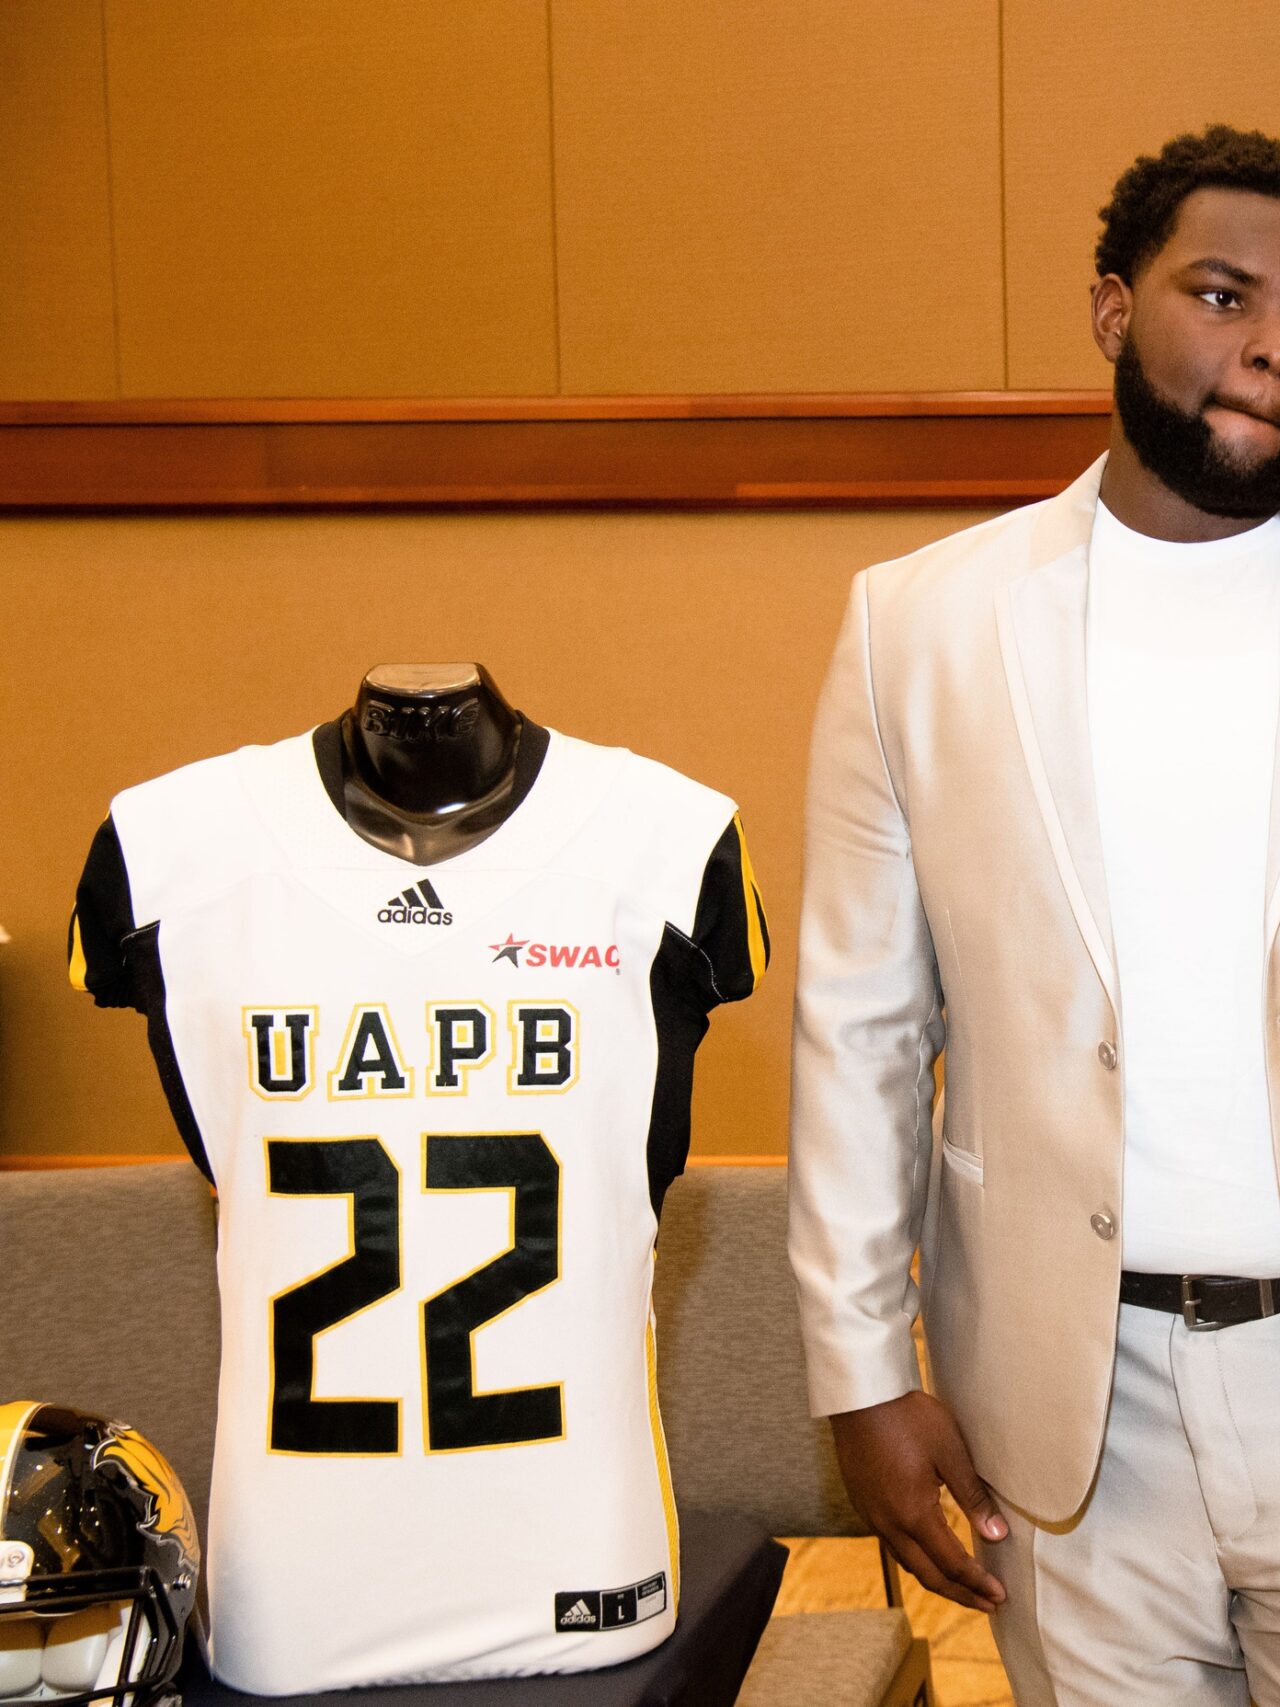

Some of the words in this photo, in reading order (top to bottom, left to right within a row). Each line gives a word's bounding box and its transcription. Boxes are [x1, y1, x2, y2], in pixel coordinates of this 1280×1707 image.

[377, 905, 454, 926] adidas
[525, 943, 620, 968] SWAC
[242, 1000, 581, 1101] UAPB
[263, 1130, 566, 1458] 22
[560, 1614, 597, 1625] adidas
[617, 1605, 625, 1620] L
